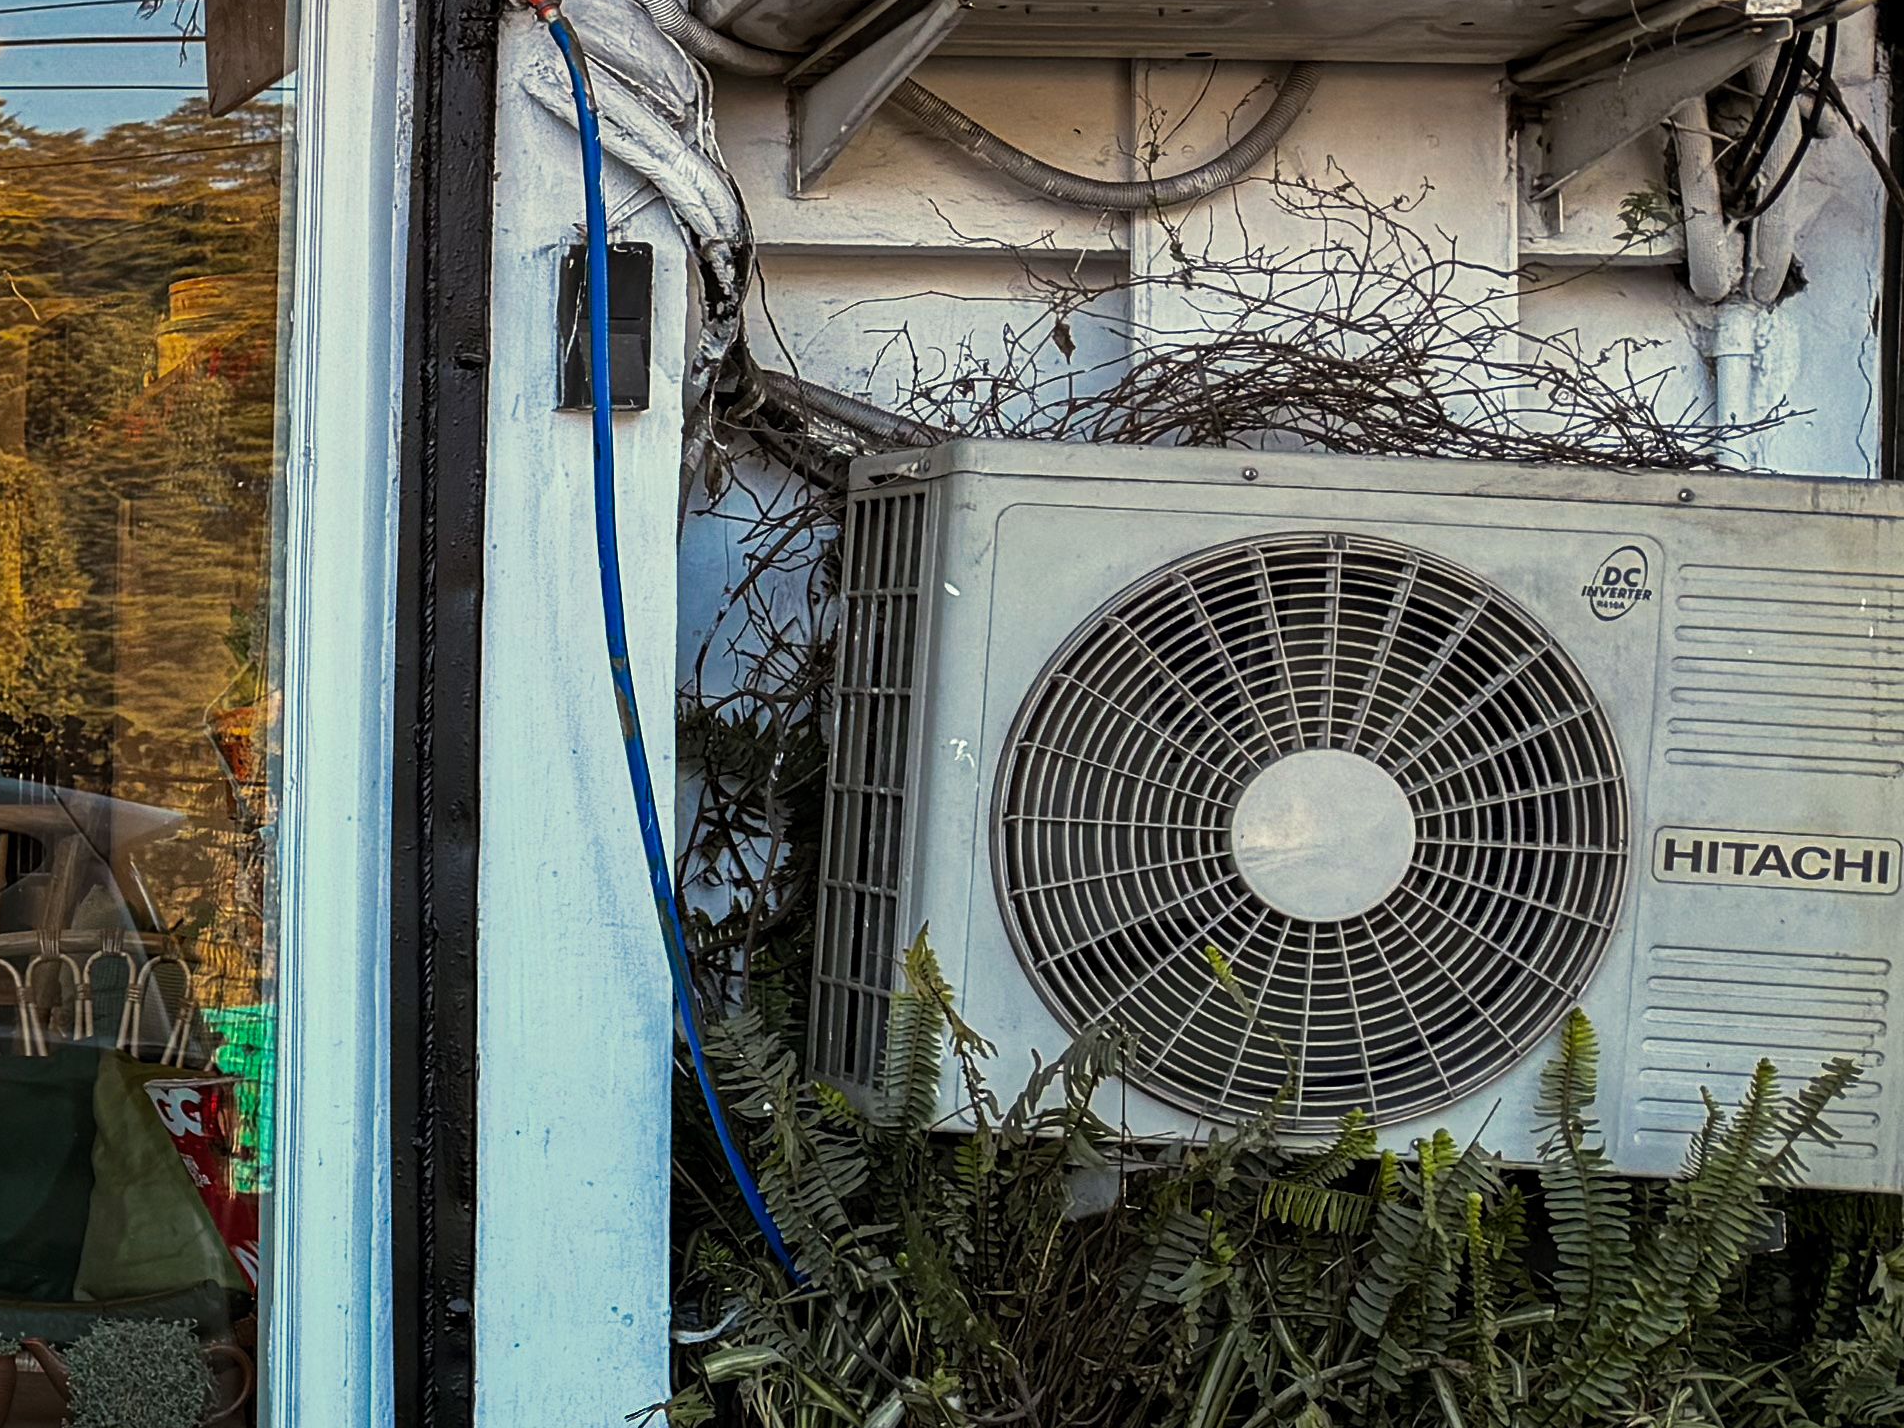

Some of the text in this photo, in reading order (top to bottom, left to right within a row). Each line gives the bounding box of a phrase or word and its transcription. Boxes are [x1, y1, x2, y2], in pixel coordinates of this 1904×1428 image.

[1602, 566, 1642, 588] DC
[1581, 585, 1653, 601] INVERTER
[1663, 837, 1890, 884] HITACHI
